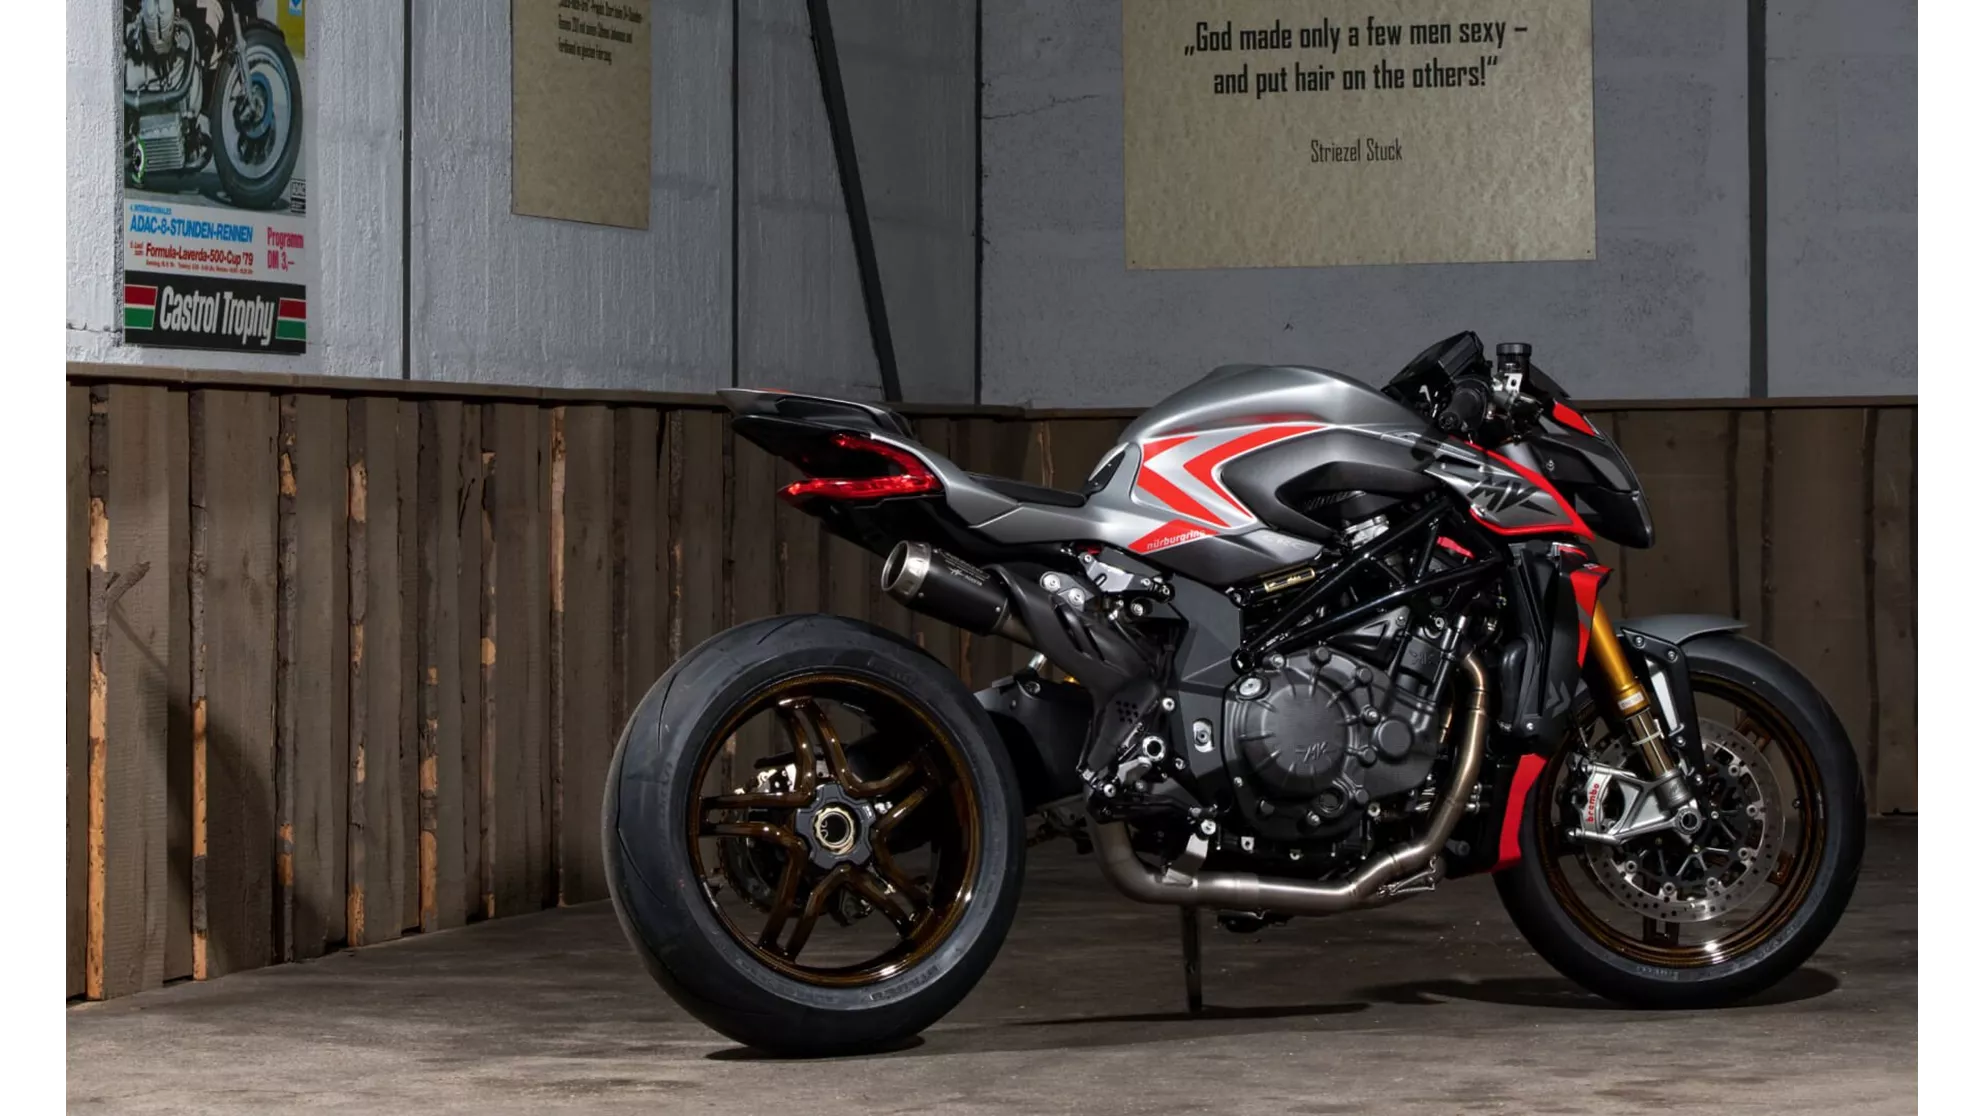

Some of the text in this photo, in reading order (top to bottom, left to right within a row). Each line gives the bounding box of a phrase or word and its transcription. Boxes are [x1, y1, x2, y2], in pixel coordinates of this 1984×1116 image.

[1184, 21, 1232, 56] „God
[1240, 19, 1292, 50] made
[1299, 17, 1340, 54] only
[1348, 27, 1359, 47] a
[1366, 16, 1402, 46] few
[1410, 23, 1451, 45] men
[1459, 20, 1506, 49] sexy
[1214, 63, 1248, 94] and
[1256, 67, 1288, 99] put
[1295, 62, 1335, 91] hair
[1343, 70, 1366, 91] on
[1373, 59, 1405, 89] the
[1311, 138, 1402, 163] Striezel Stuck
[130, 214, 253, 243] ADAC-8-STUNDEN-RENNEN
[267, 227, 304, 250] Programm
[146, 243, 242, 265] Formula-Laverda-500-Cup
[159, 285, 275, 346] Castrol Trophy
[1586, 782, 1600, 824] brembo
